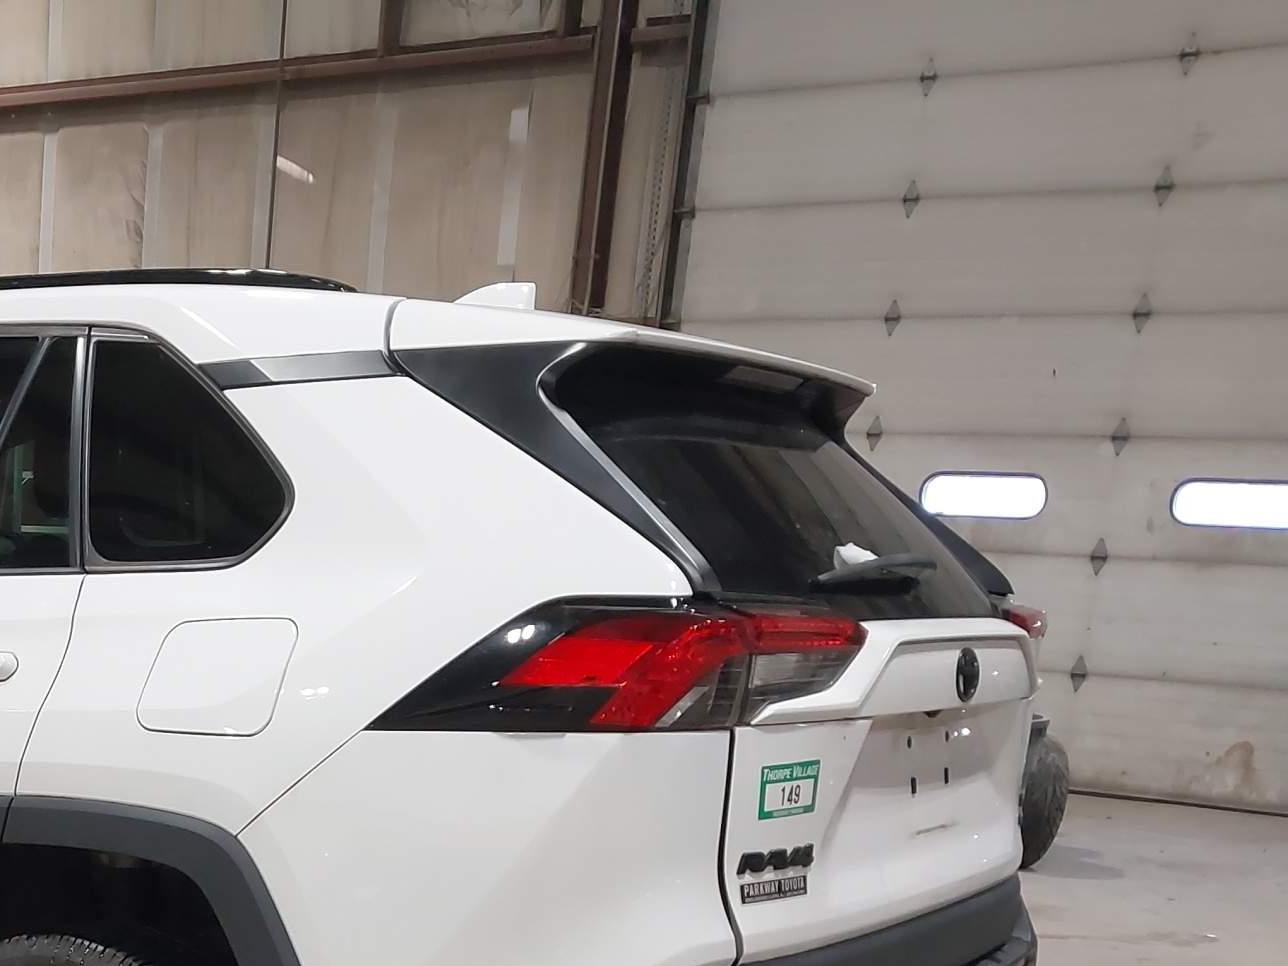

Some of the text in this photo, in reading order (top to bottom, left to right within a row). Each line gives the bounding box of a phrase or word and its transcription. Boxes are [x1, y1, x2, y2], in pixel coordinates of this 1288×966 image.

[780, 784, 801, 807] 149
[743, 880, 779, 897] PARKWAY
[780, 876, 805, 892] TOYOTA
